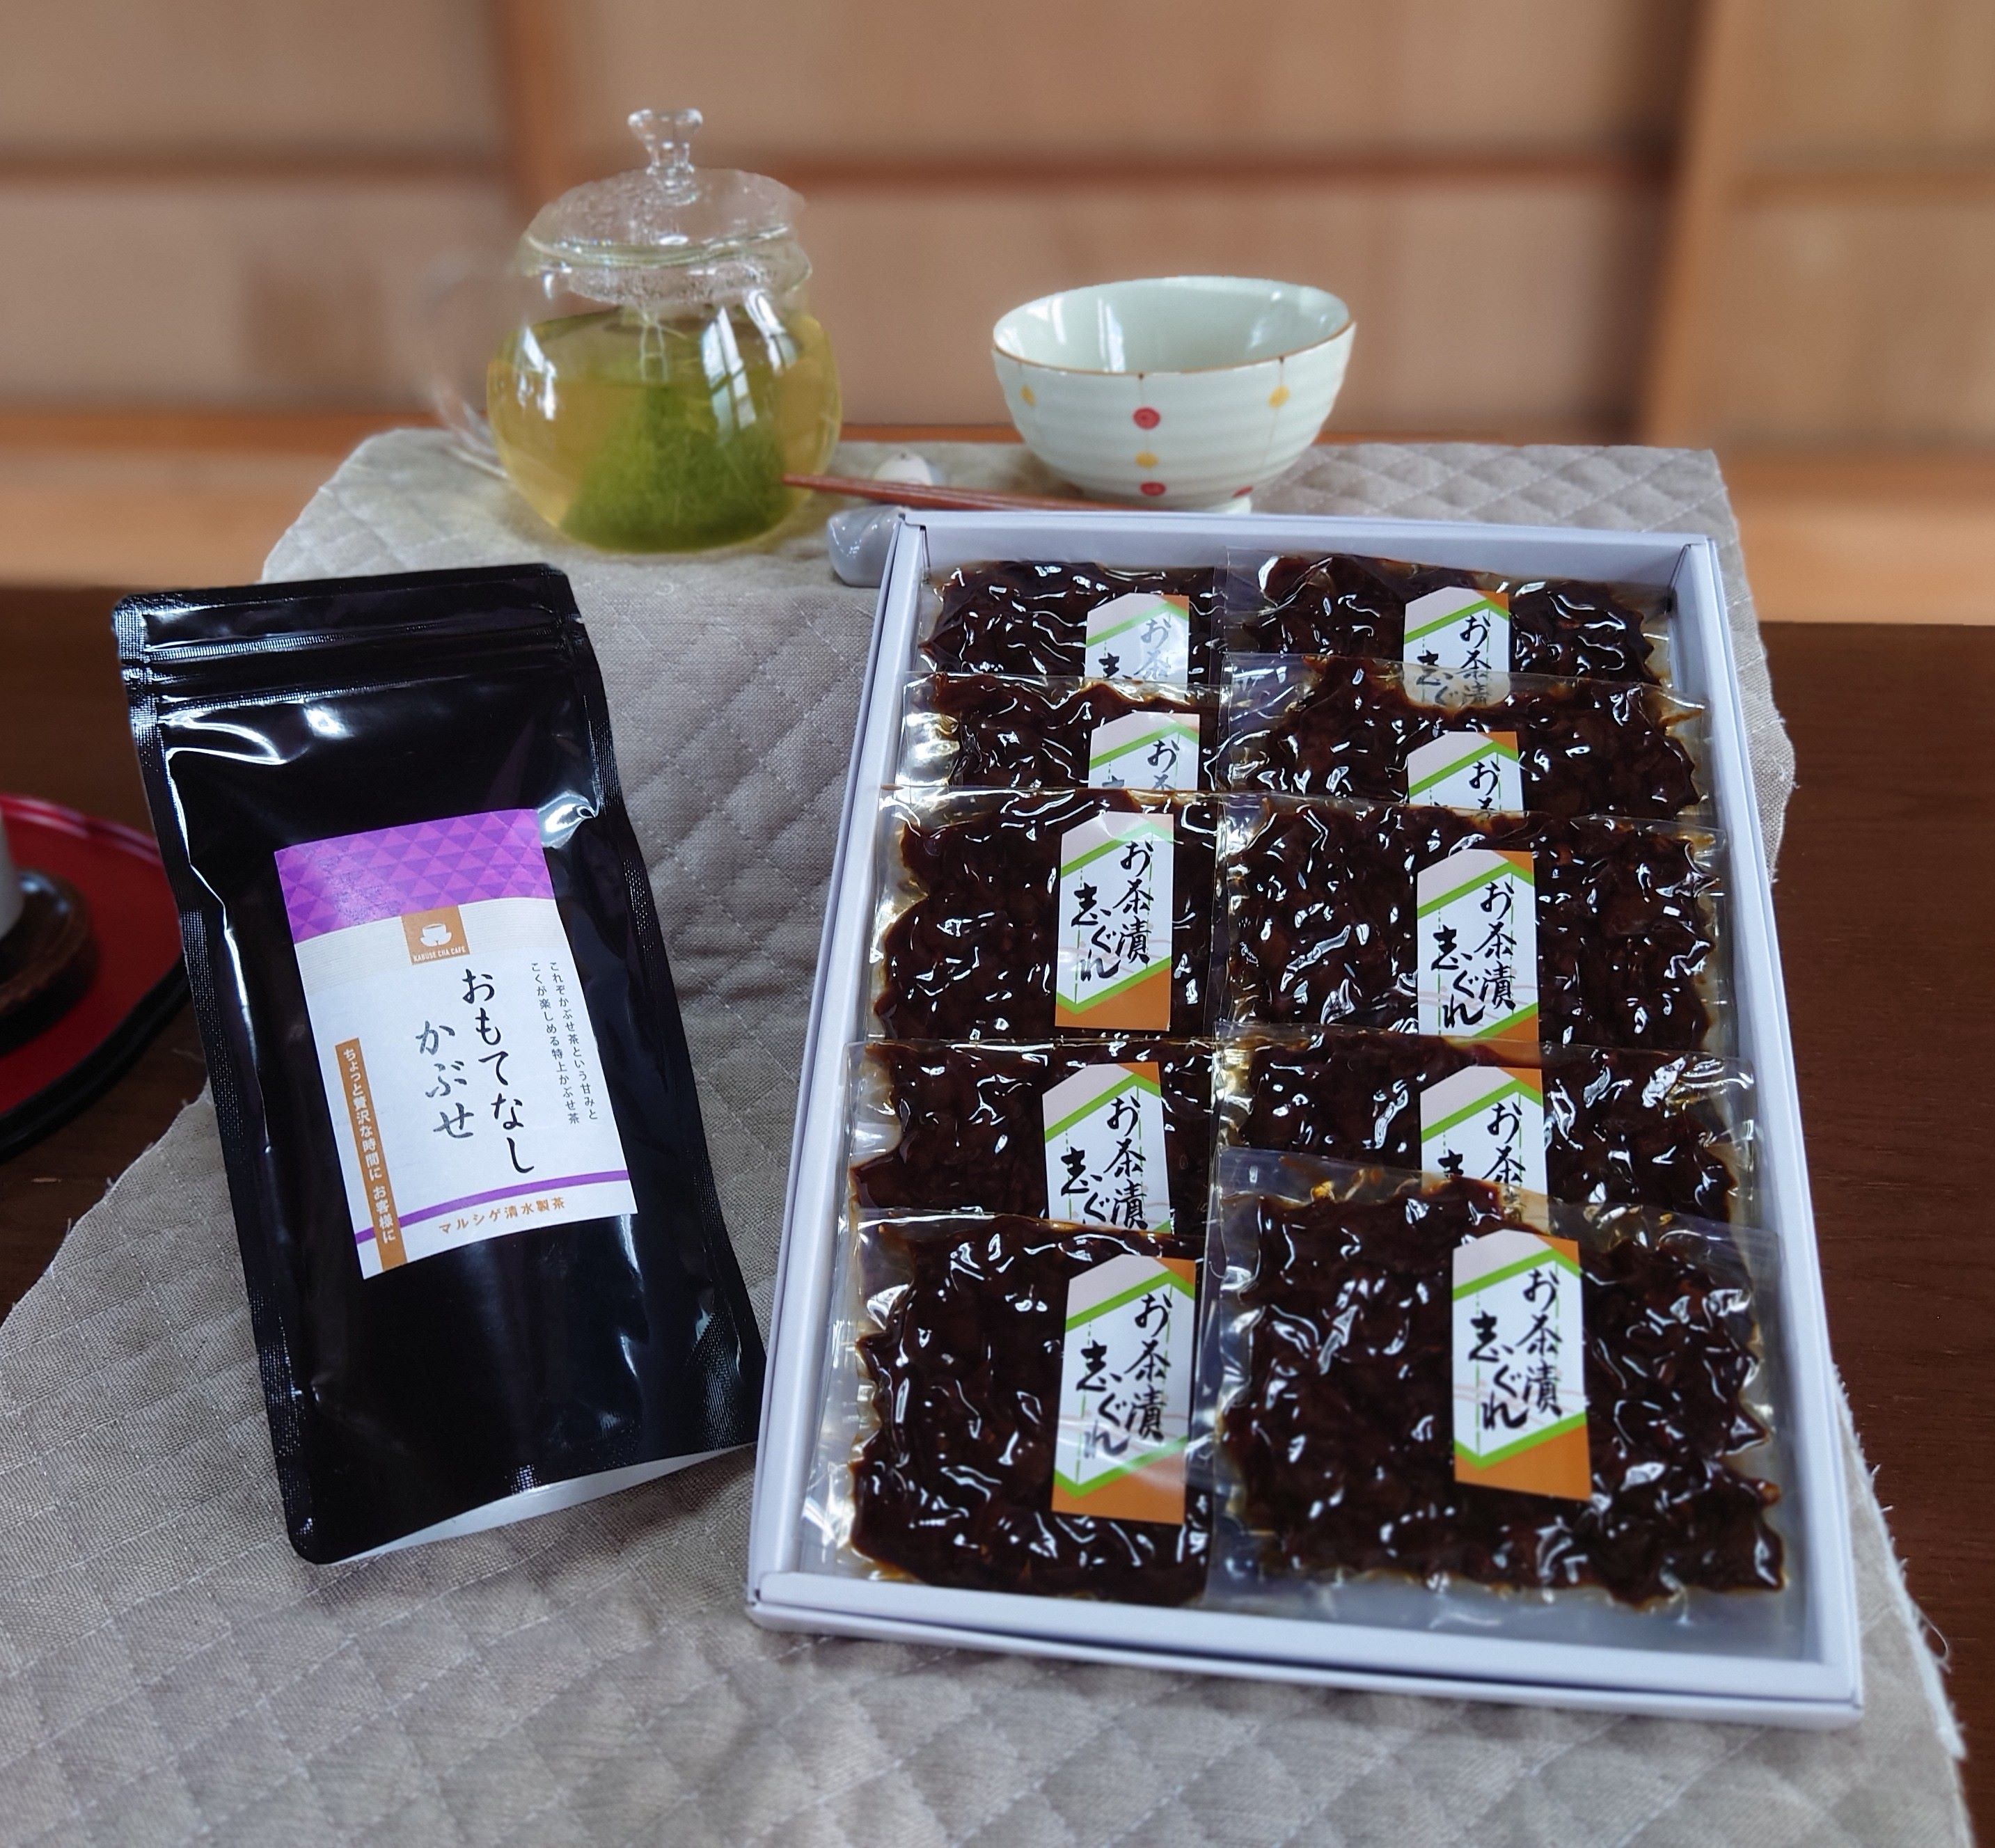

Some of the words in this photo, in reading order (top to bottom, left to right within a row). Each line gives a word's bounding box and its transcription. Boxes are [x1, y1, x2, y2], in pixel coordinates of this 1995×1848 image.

[451, 946, 466, 955] CAFE
[1112, 841, 1154, 964] お茶漬
[1474, 881, 1517, 1011] お茶漬
[416, 1020, 474, 1139] かぶせ
[462, 968, 535, 1174] おもてなし
[531, 963, 579, 1124] こくが楽しめる特上かぶせ茶
[550, 962, 598, 1120] これぞかぶせ茶という甘みと
[439, 1197, 565, 1234] マルシゲ清水製茶
[1103, 1096, 1149, 1230] お茶漬
[1482, 1102, 1526, 1204] お茶
[1125, 1293, 1172, 1442] お茶漬
[1516, 1267, 1563, 1417] お茶漬
